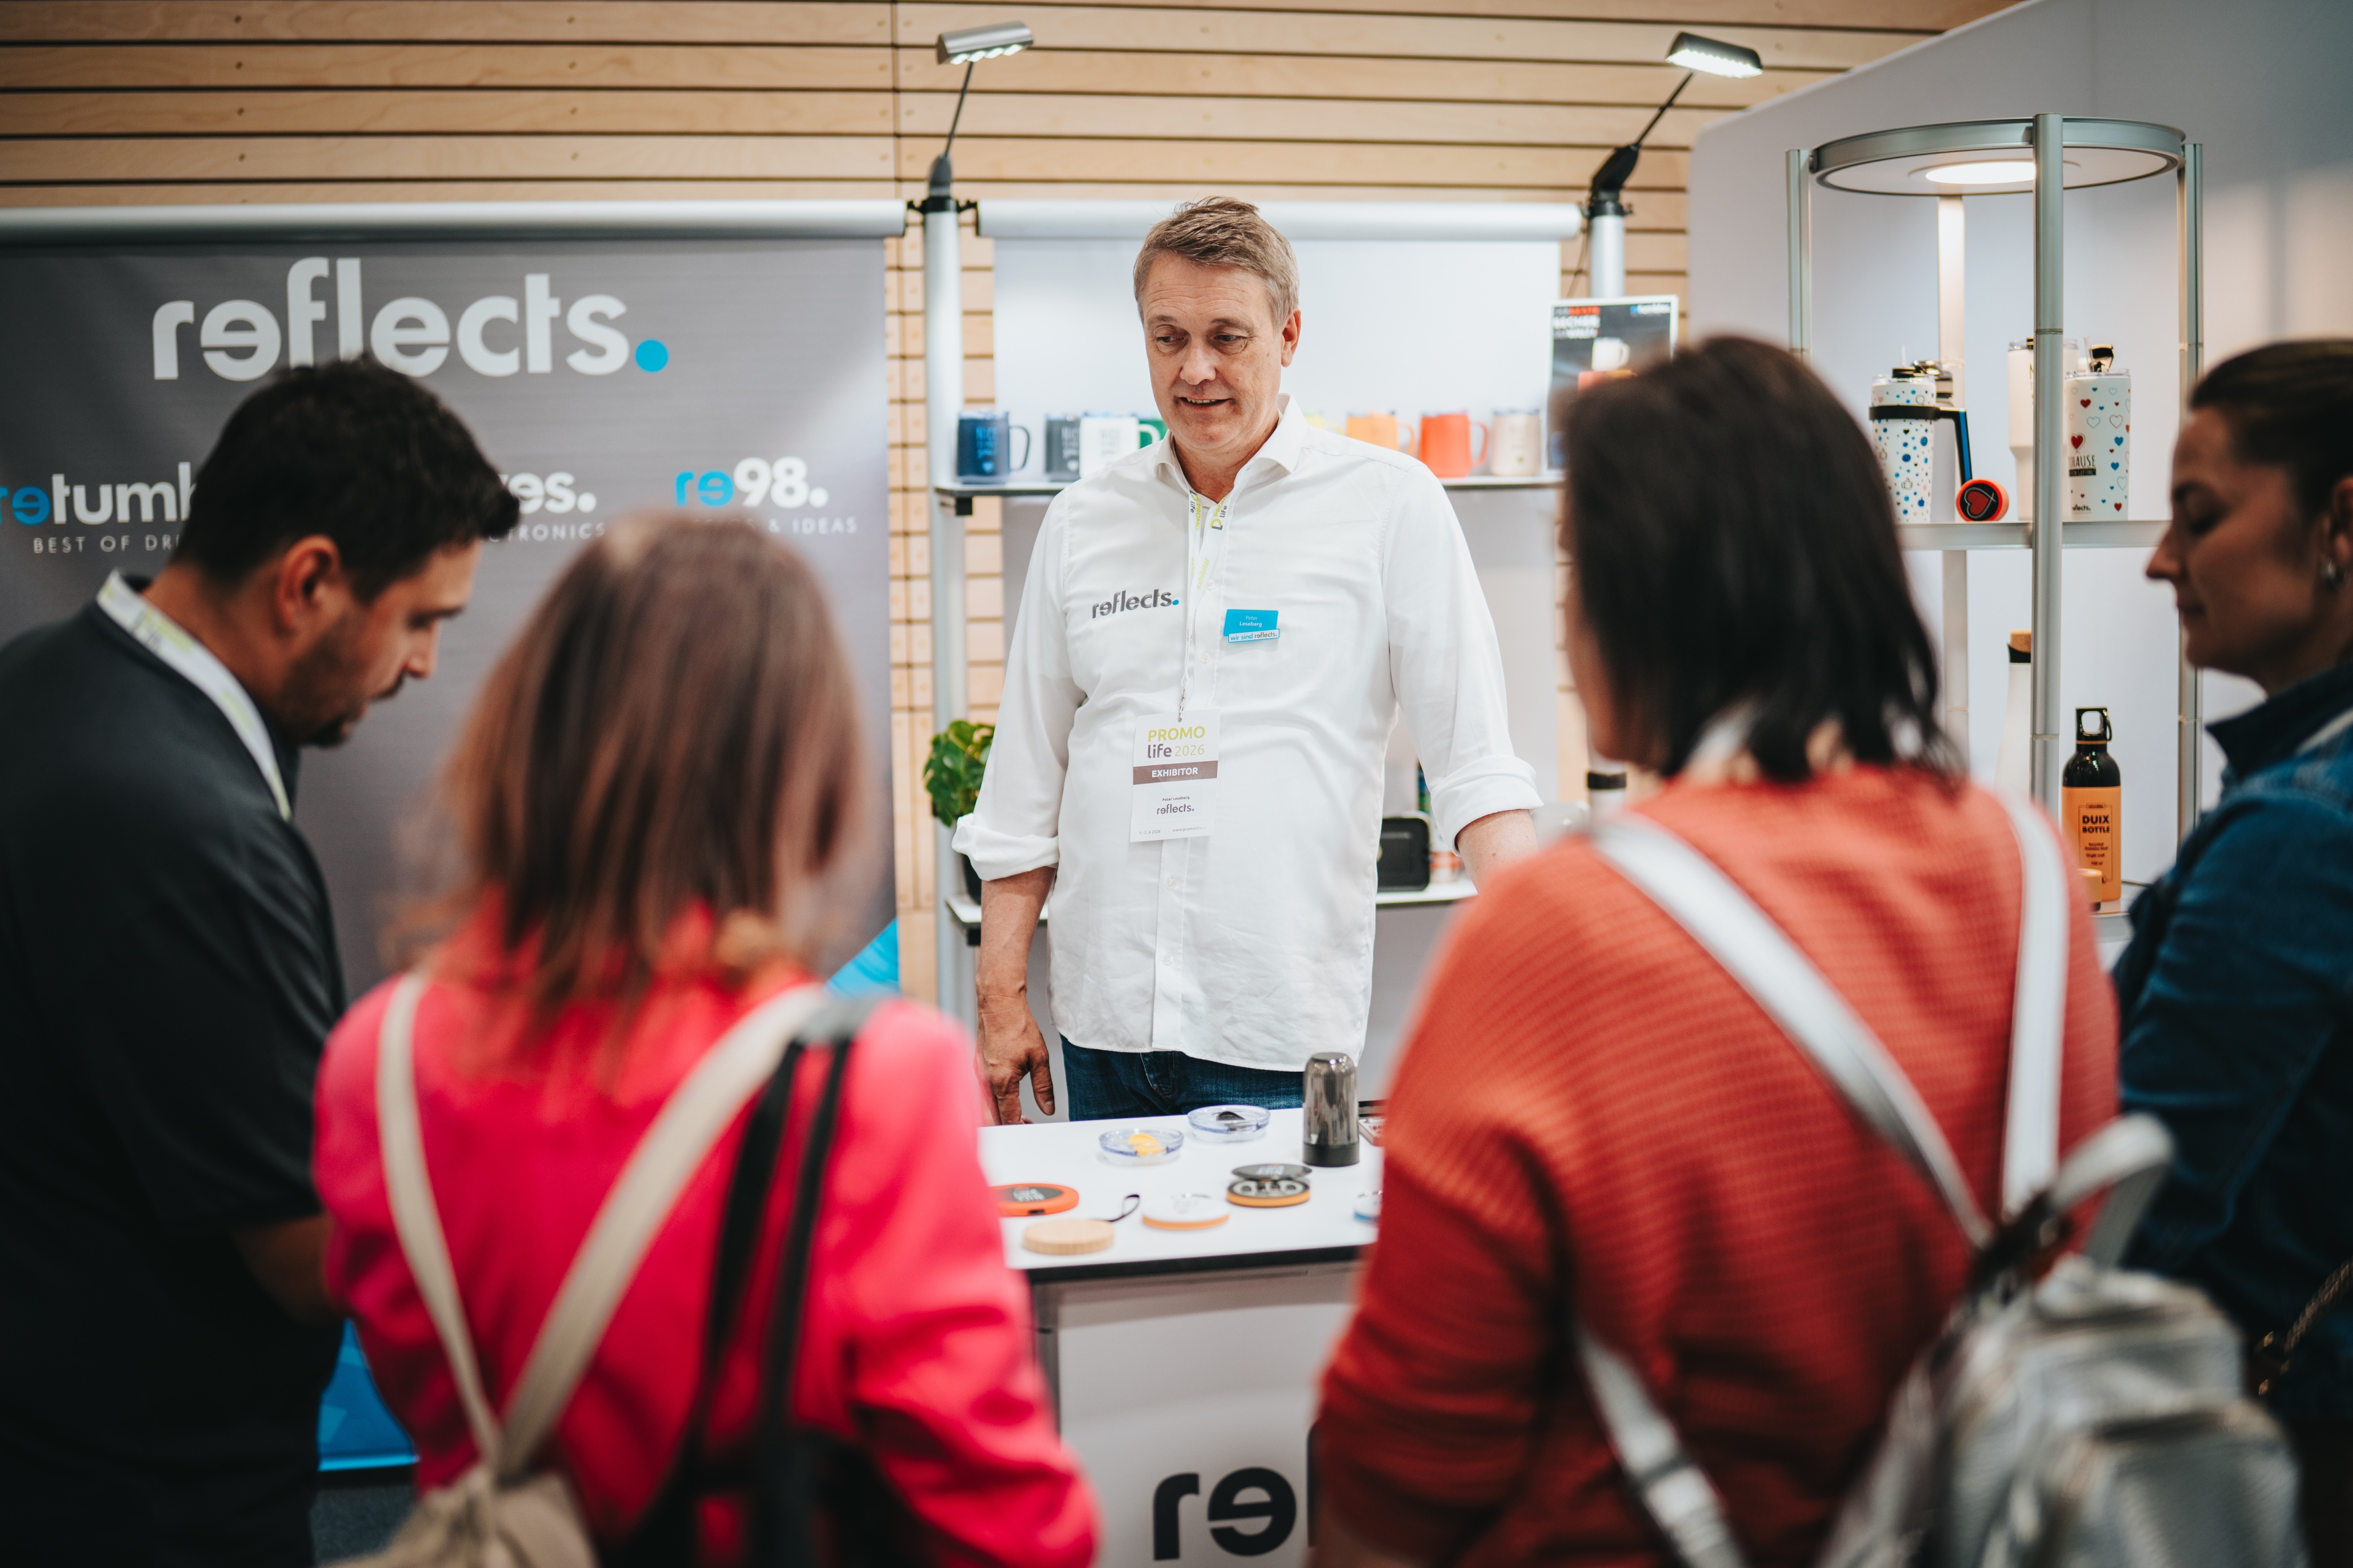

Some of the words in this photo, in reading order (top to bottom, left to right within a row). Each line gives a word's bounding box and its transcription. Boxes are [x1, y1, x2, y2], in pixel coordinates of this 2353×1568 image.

[153, 256, 669, 381] reflects.
[675, 456, 828, 509] re98.
[498, 472, 597, 515] es.
[792, 516, 857, 535] IDEAS
[33, 537, 86, 553] BEST
[100, 535, 130, 552] OF
[1196, 557, 1210, 589] exhibitor
[1092, 589, 1180, 619] reflects.
[1148, 725, 1205, 742] PROMO
[1147, 743, 1172, 759] life
[1175, 744, 1205, 757] 2026
[1151, 767, 1199, 778] EXHIBITOR
[1156, 803, 1195, 815] reflects.
[2082, 815, 2109, 824] DUIX
